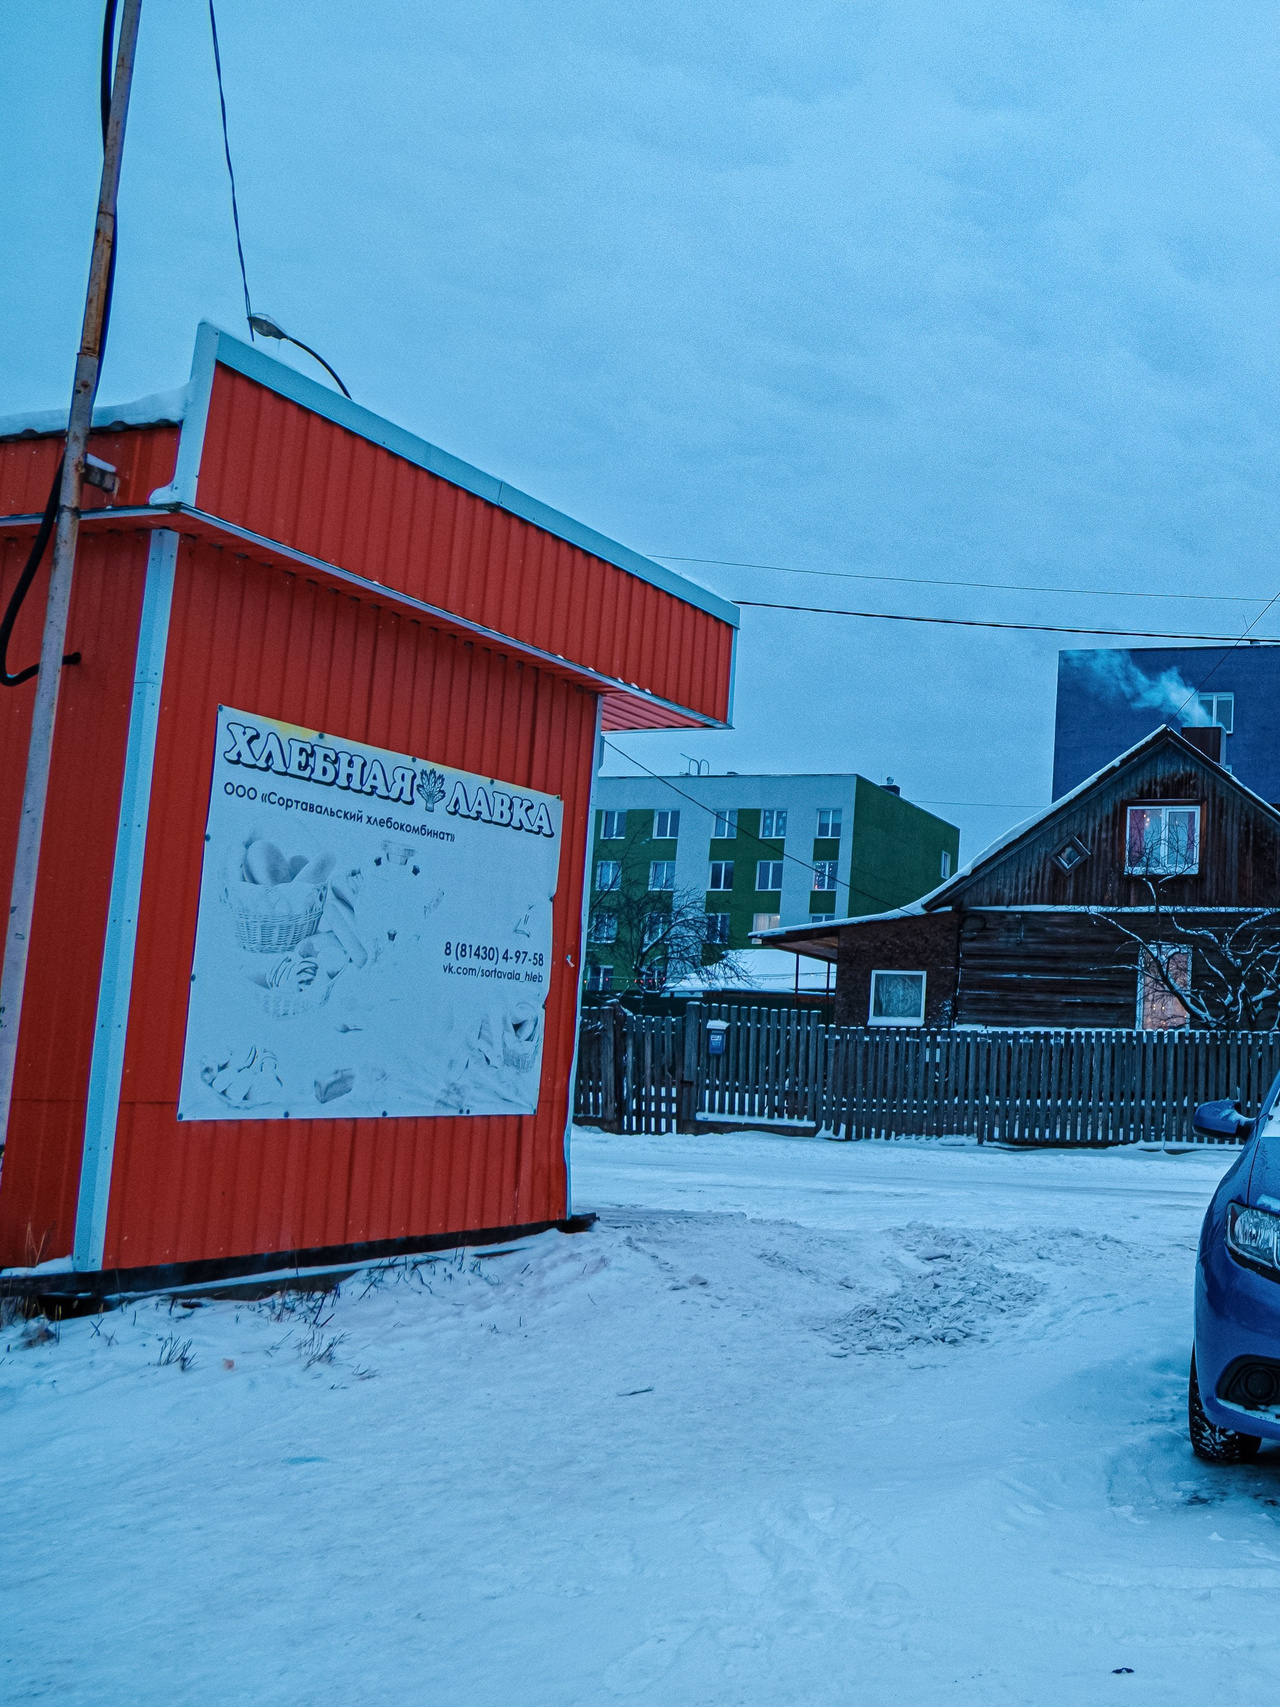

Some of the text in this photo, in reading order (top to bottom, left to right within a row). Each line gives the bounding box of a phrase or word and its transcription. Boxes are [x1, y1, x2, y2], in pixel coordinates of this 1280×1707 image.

[223, 722, 555, 838] ХЛЕБНАЯ ЛАВКА
[224, 782, 455, 842] ООО «Сортавальский хлебокомбинат»
[443, 962, 543, 983] vk.com/sortavala_hleb
[444, 941, 544, 967] 8 (81430) 4-97-58
